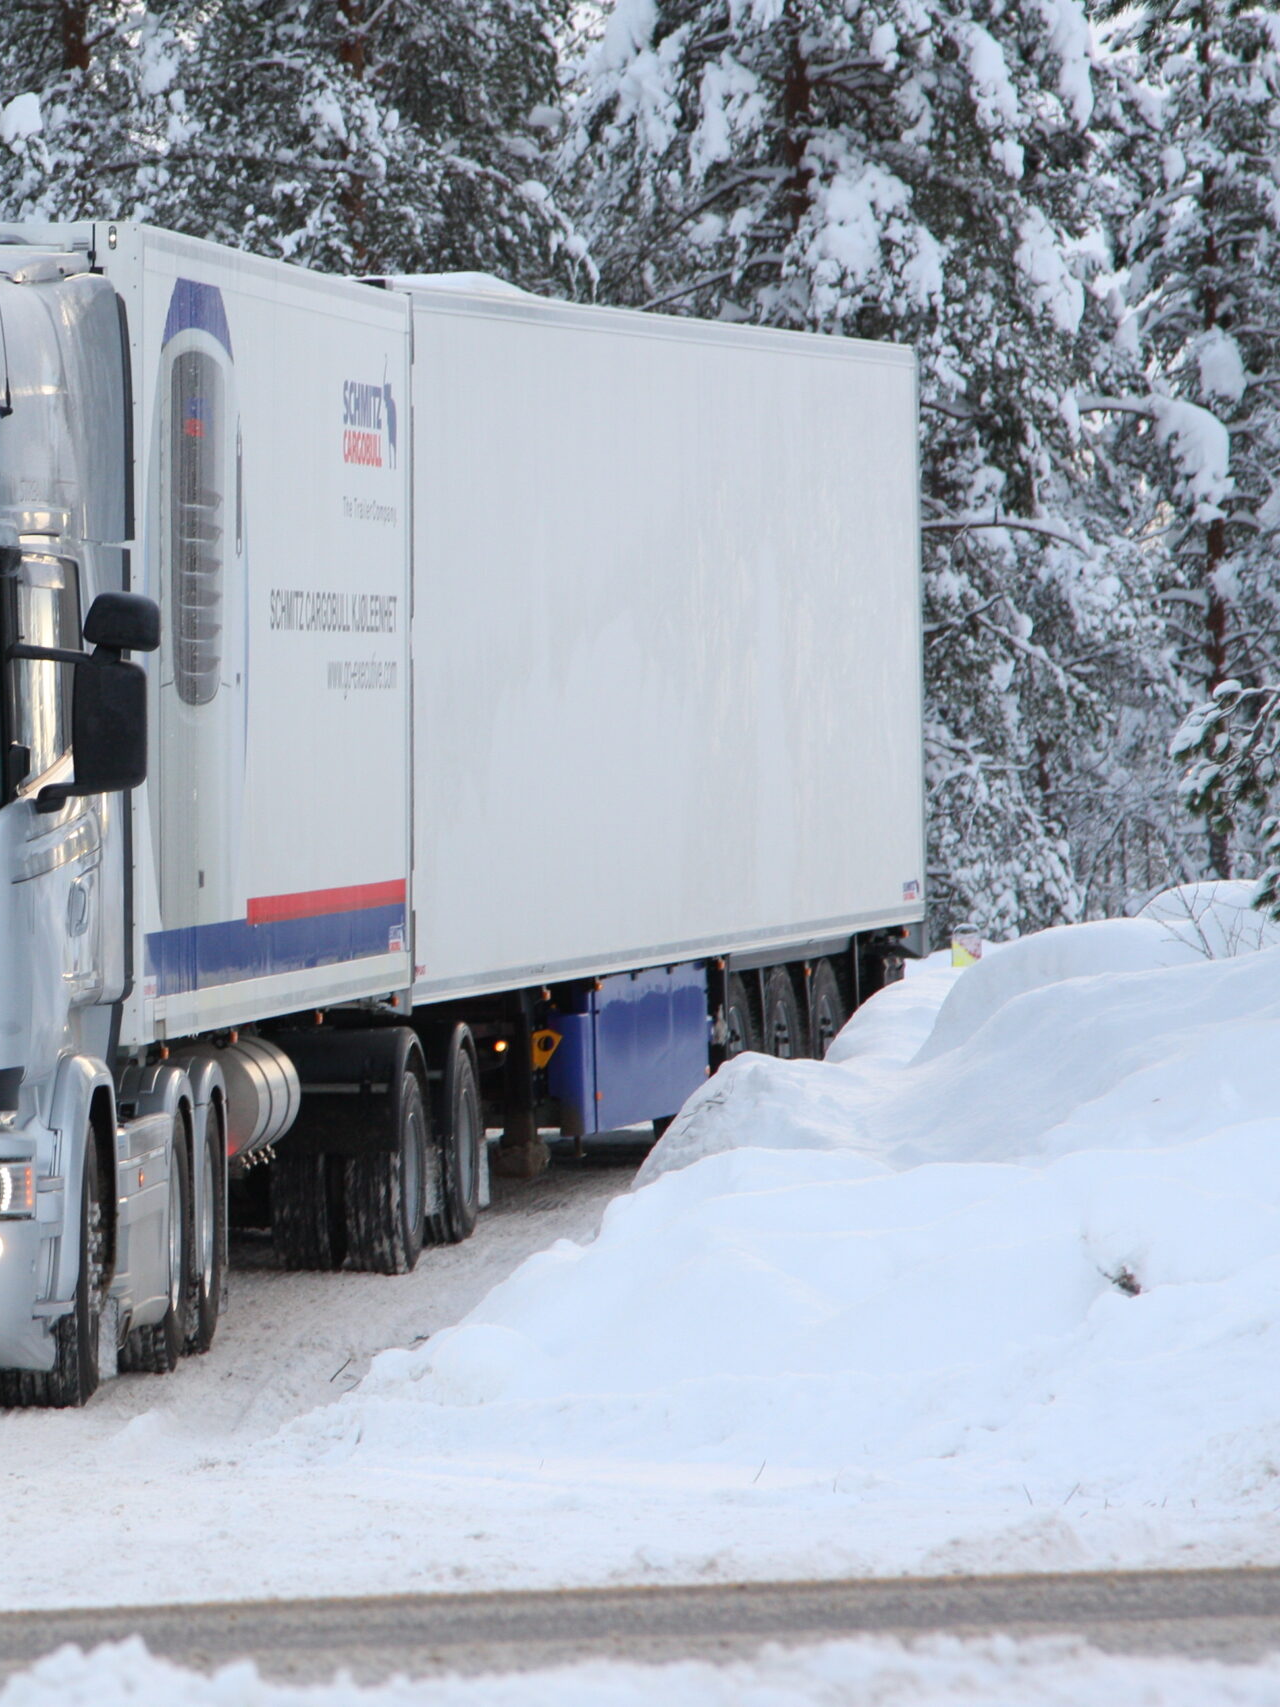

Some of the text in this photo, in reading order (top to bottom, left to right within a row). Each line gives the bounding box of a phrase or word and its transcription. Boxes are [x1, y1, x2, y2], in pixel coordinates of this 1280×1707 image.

[343, 379, 382, 430] SCHMITZ
[343, 429, 382, 468] CARGOBULL
[270, 588, 304, 631] SCHMITZ
[305, 591, 350, 632] CARGOBULL
